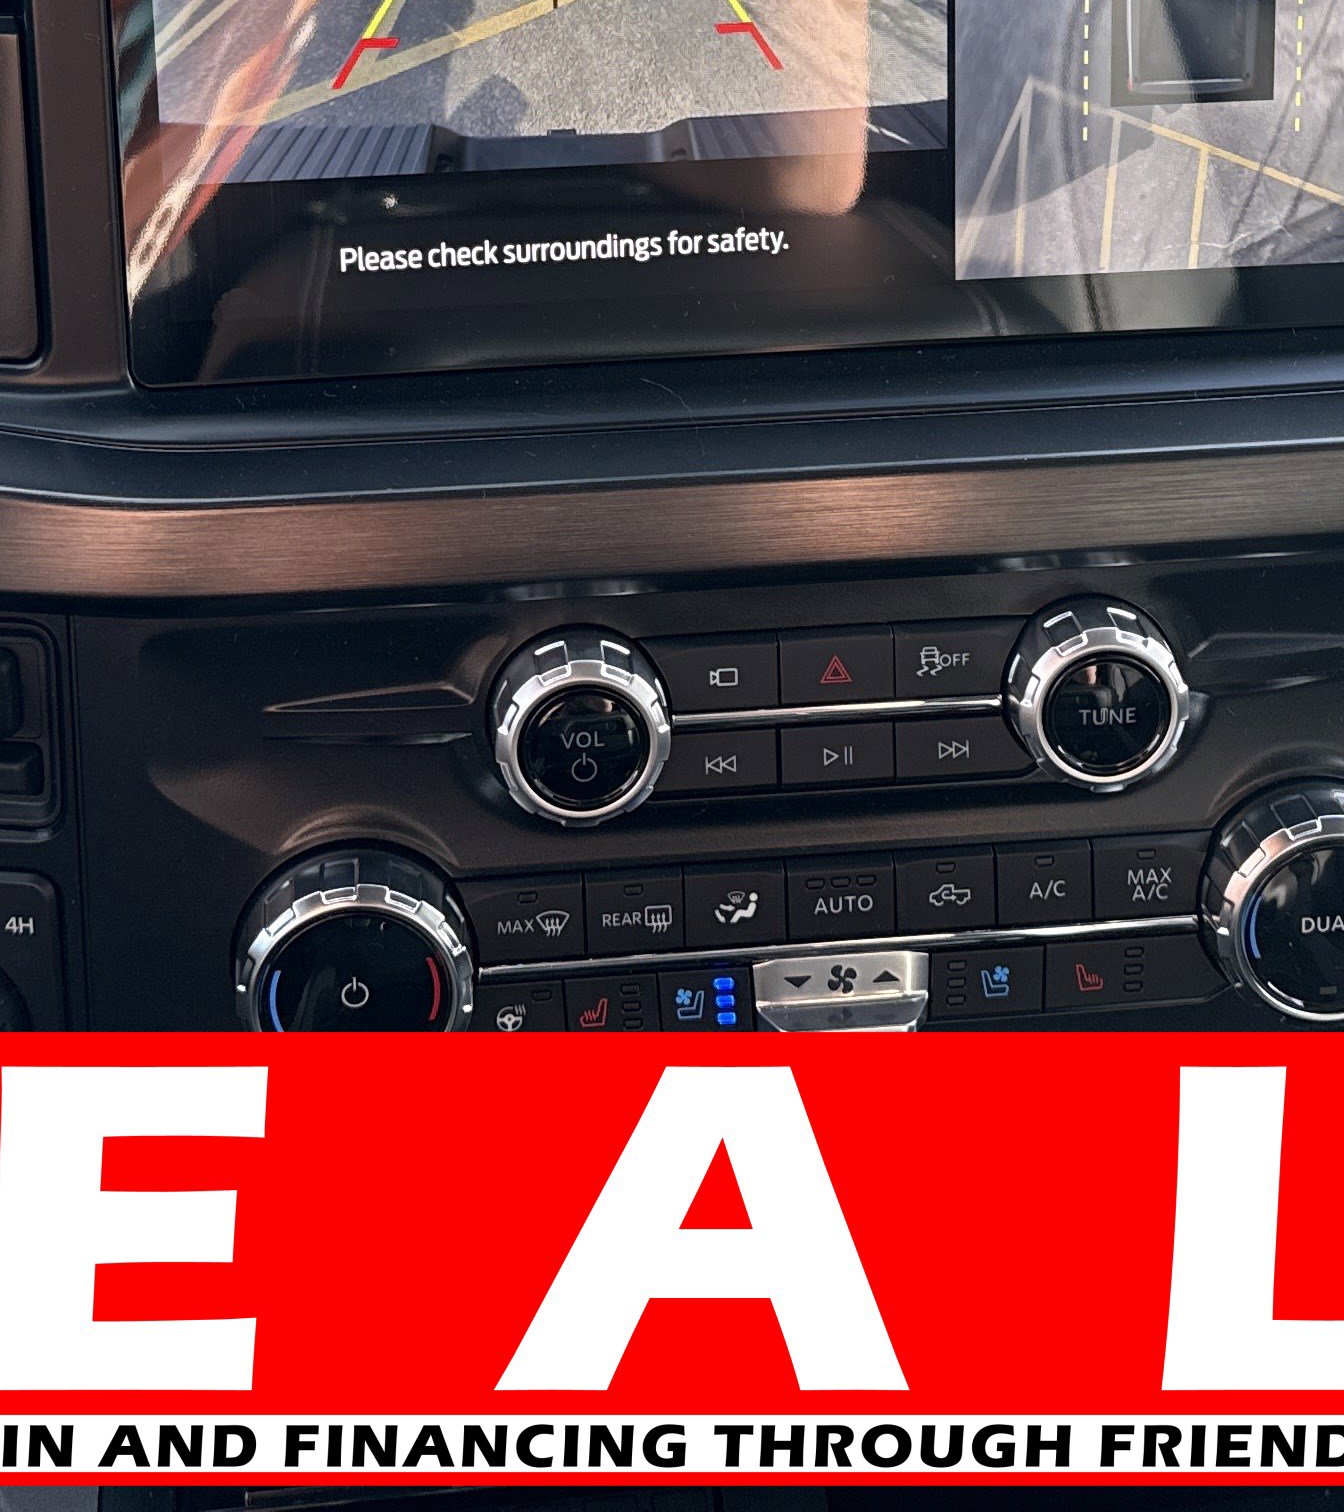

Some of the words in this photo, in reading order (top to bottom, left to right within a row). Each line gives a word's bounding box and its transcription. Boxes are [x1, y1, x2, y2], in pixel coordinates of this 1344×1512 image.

[340, 245, 423, 272] Please
[427, 240, 499, 268] check
[503, 233, 663, 264] surroundings
[667, 230, 703, 255] for
[707, 227, 790, 255] safety.
[940, 652, 970, 669] OFF
[1078, 707, 1137, 726] TUNE
[561, 731, 606, 750] VOL
[1126, 867, 1172, 885] MAX
[1028, 879, 1067, 900] A/C
[1131, 883, 1169, 901] A/C
[813, 894, 874, 915] AUTO
[4, 916, 35, 935] 4H
[496, 918, 535, 935] MAX
[601, 910, 642, 929] REAR
